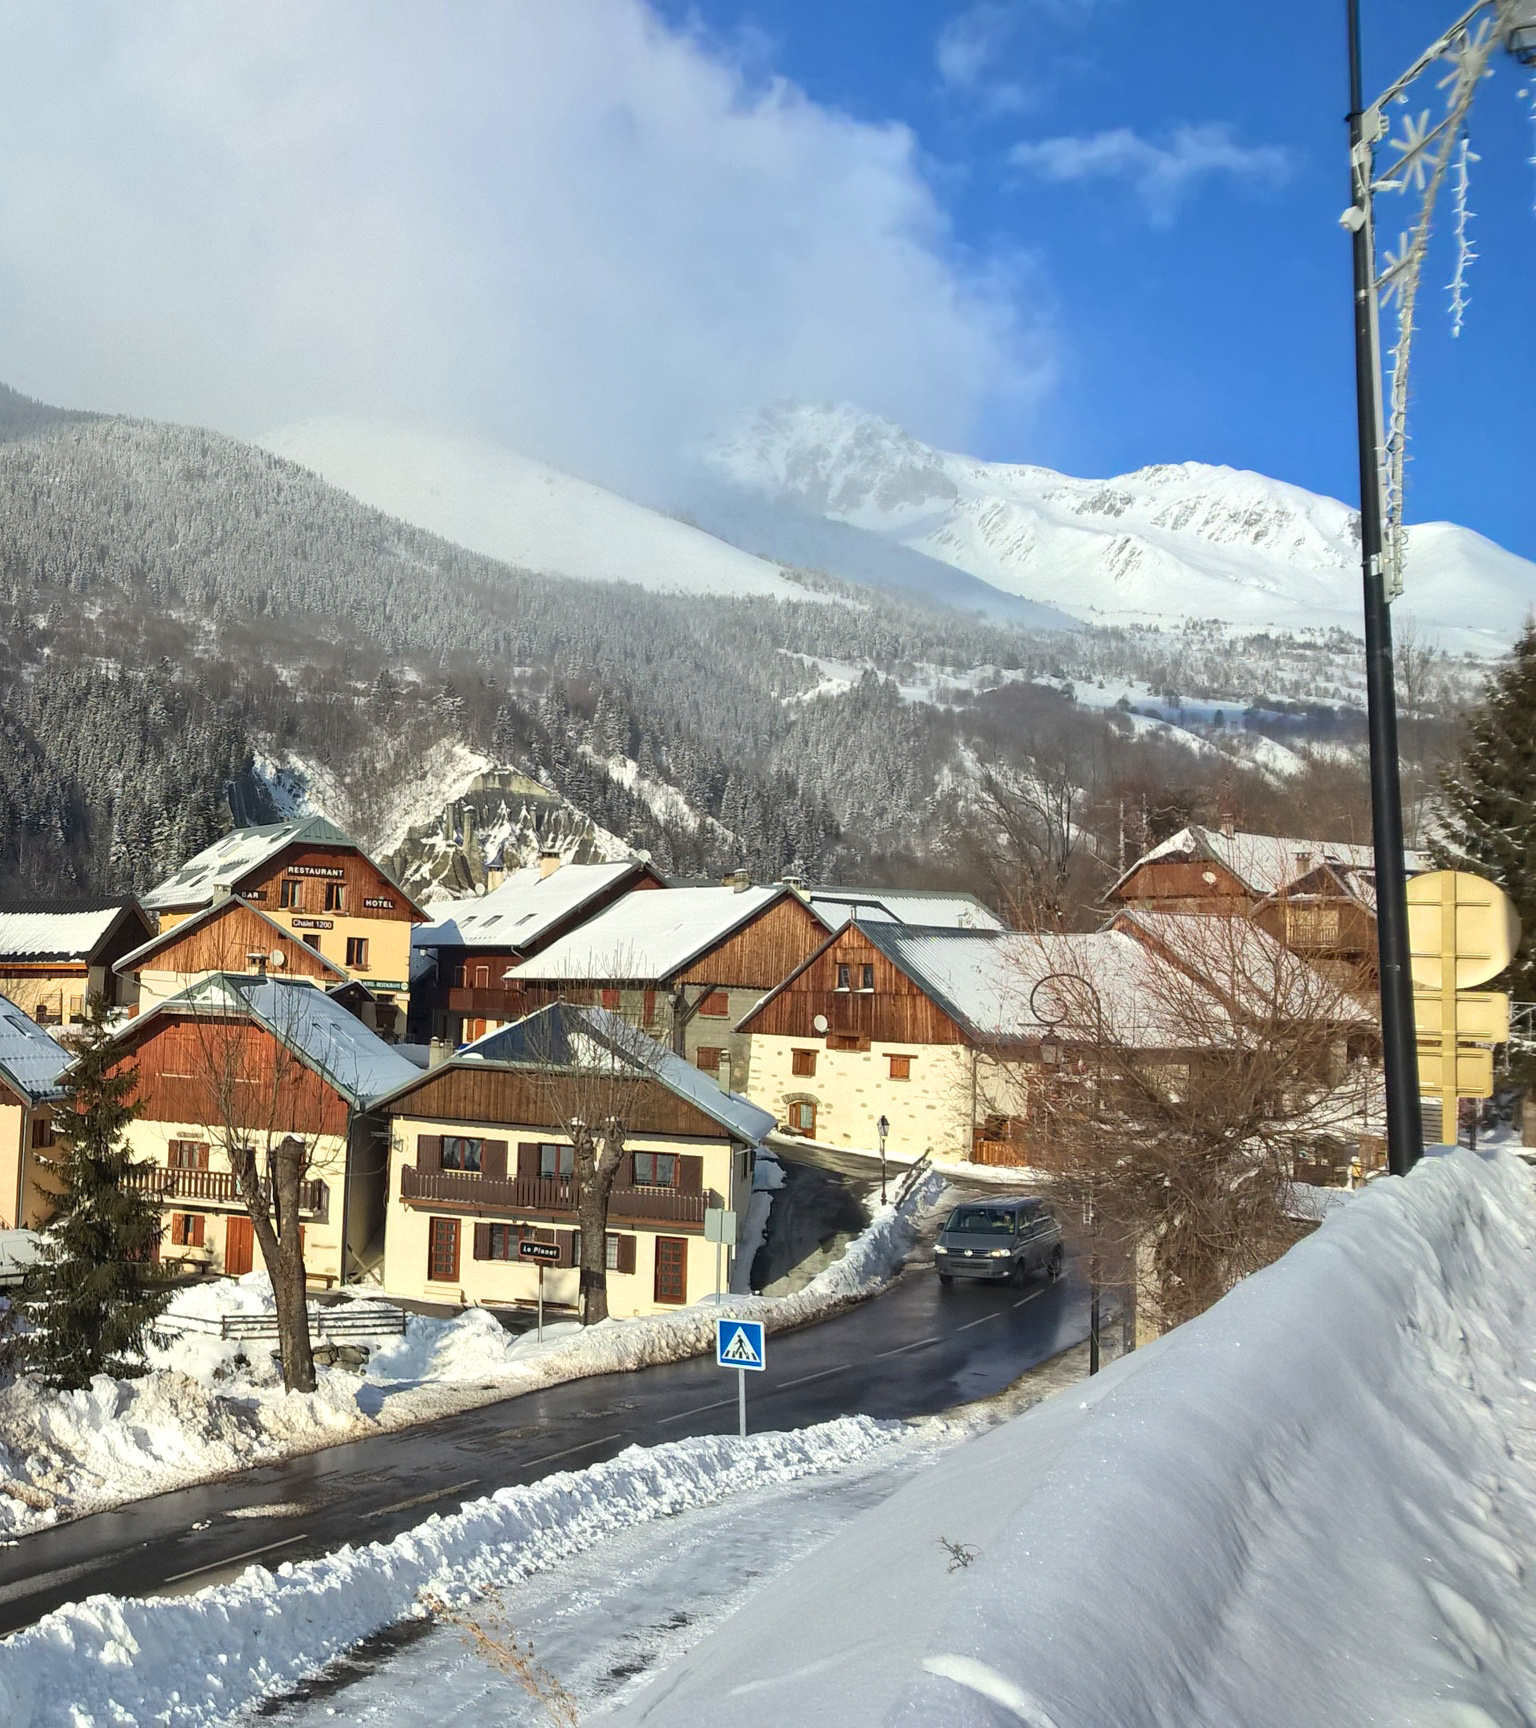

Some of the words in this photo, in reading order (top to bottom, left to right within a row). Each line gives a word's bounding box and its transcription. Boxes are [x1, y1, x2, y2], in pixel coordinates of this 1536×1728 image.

[288, 866, 344, 876] RESTAURANT
[241, 891, 259, 899] BAR
[365, 899, 394, 908] HOTEL
[293, 919, 314, 928] Chalet
[315, 921, 332, 929] 1200
[523, 1245, 532, 1253] Le
